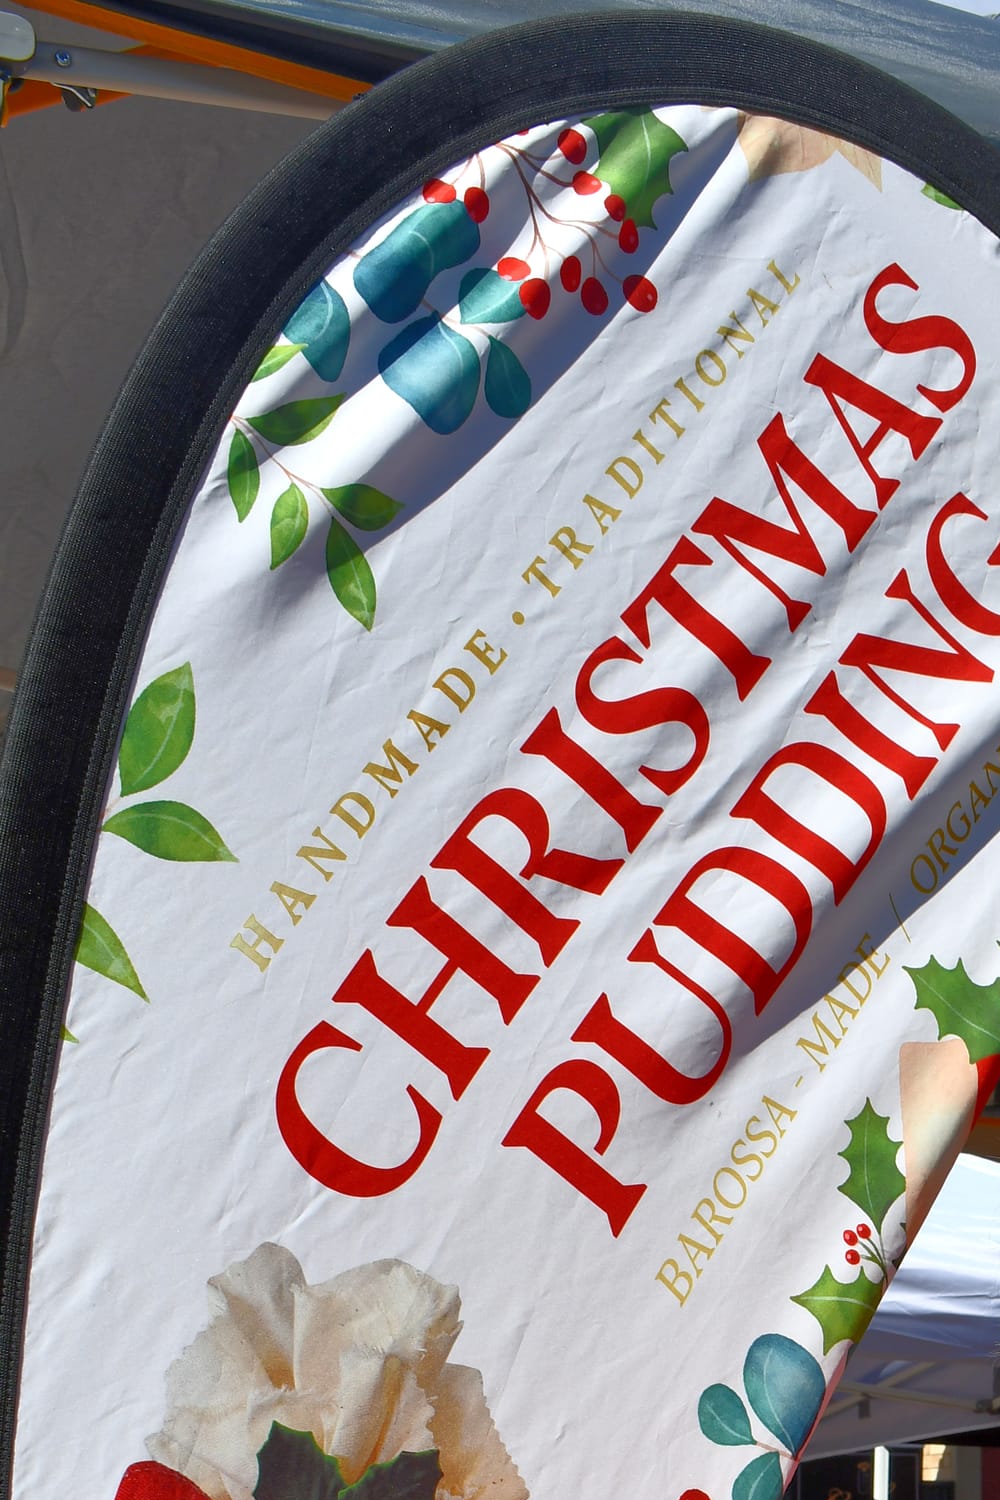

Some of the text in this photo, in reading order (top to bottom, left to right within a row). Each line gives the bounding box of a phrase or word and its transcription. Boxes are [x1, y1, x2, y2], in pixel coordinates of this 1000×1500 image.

[229, 259, 802, 974] HANDMADE TRADITIONAL
[275, 262, 978, 1198] CHRISTMAS
[653, 1094, 799, 1307] BAROSSA
[795, 932, 892, 1073] MADE
